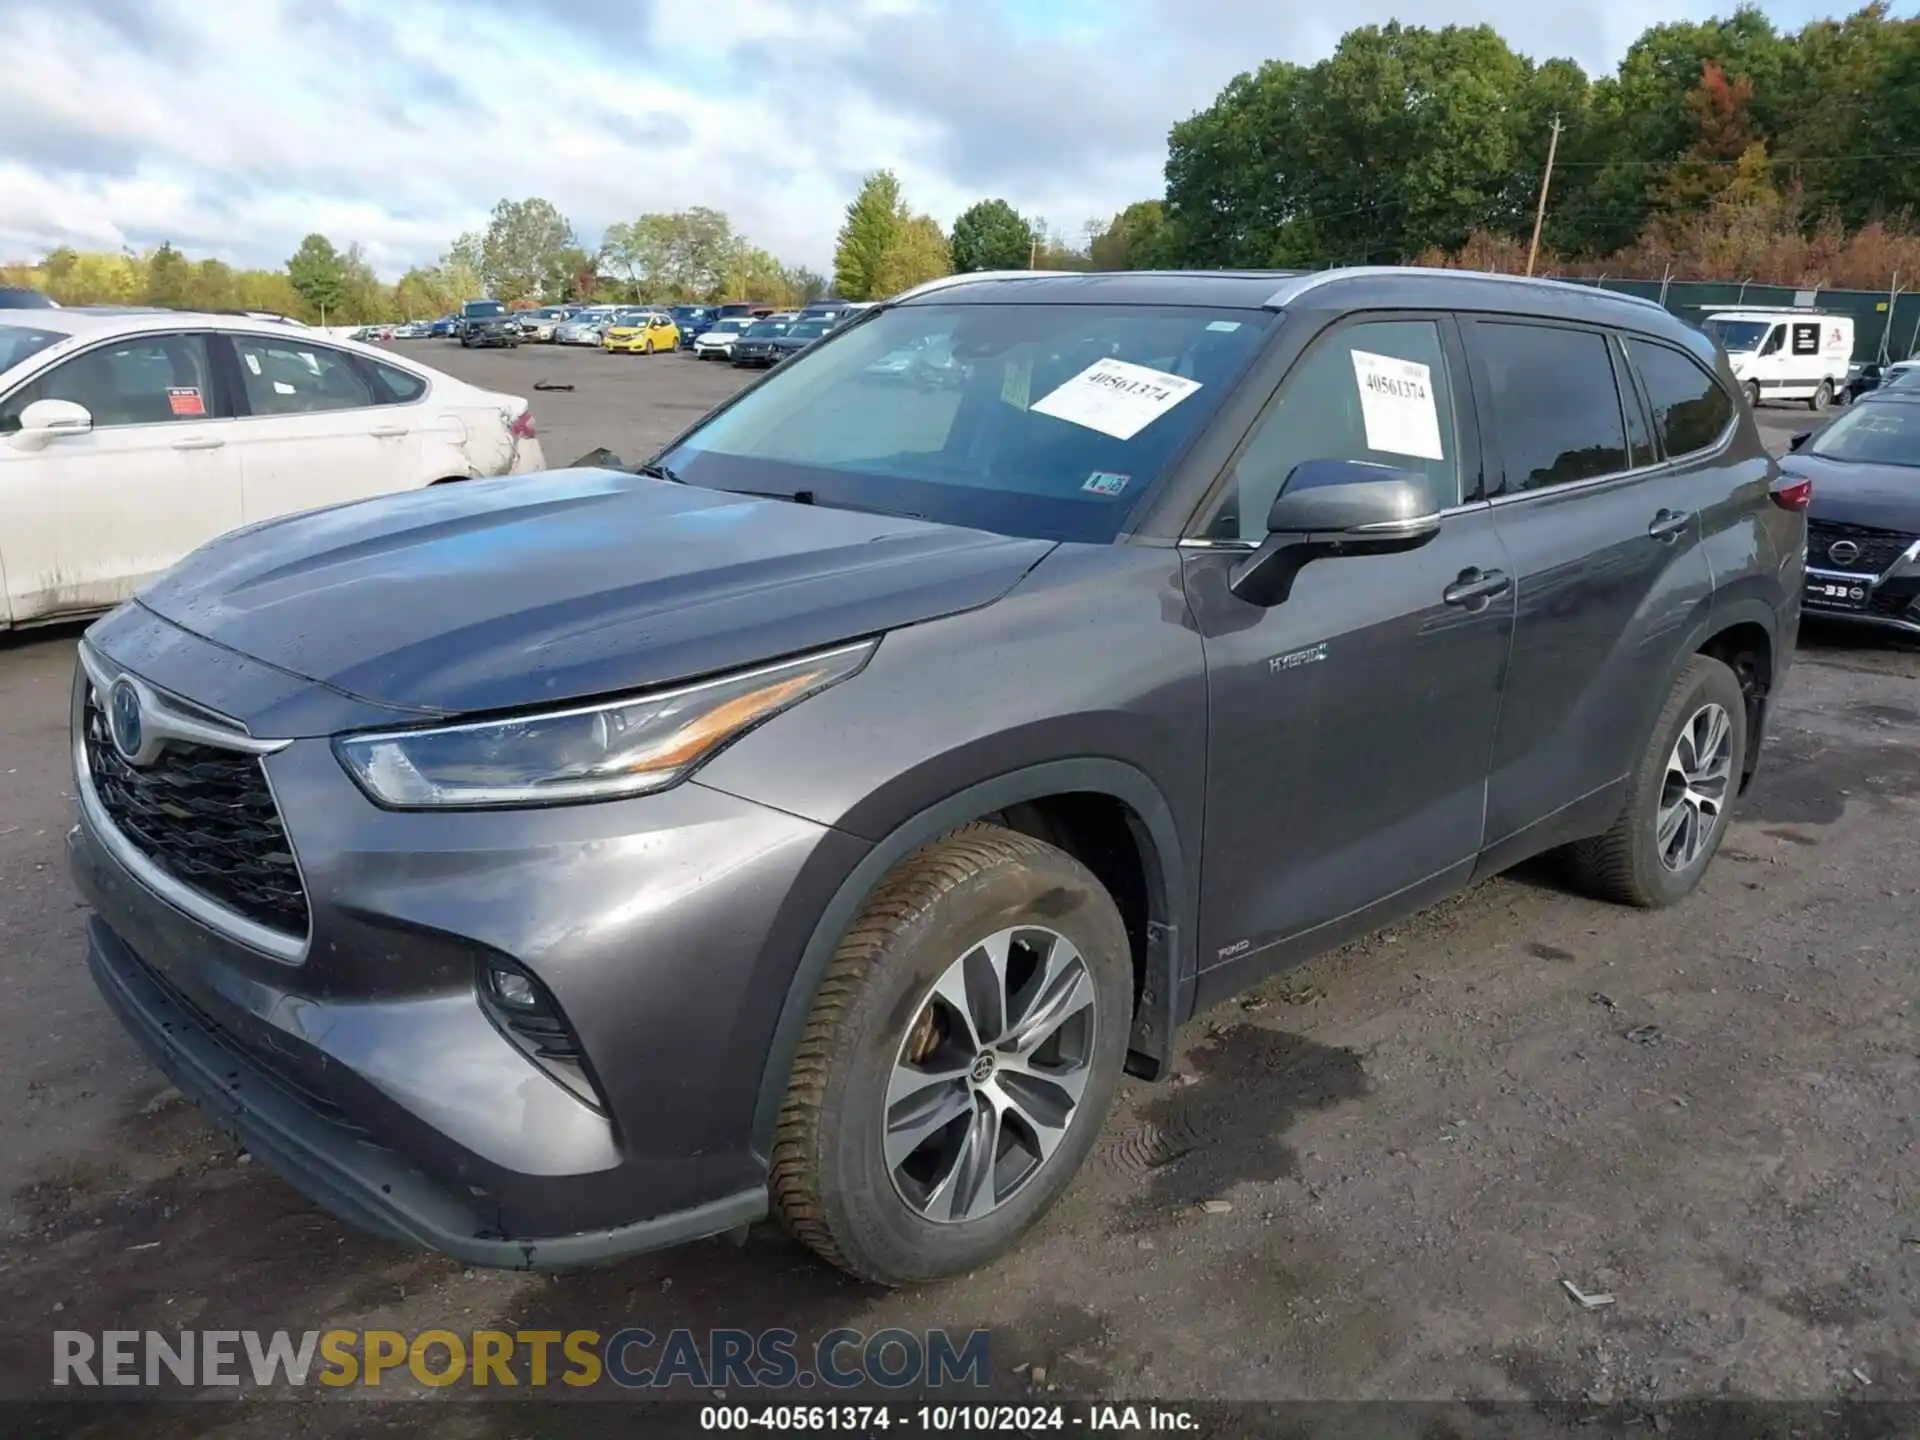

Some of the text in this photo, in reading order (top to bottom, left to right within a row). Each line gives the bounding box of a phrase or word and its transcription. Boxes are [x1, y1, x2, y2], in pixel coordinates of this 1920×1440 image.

[1088, 372, 1171, 402] 40561374
[1366, 373, 1426, 400] 40561374
[1268, 648, 1319, 674] HYBRID
